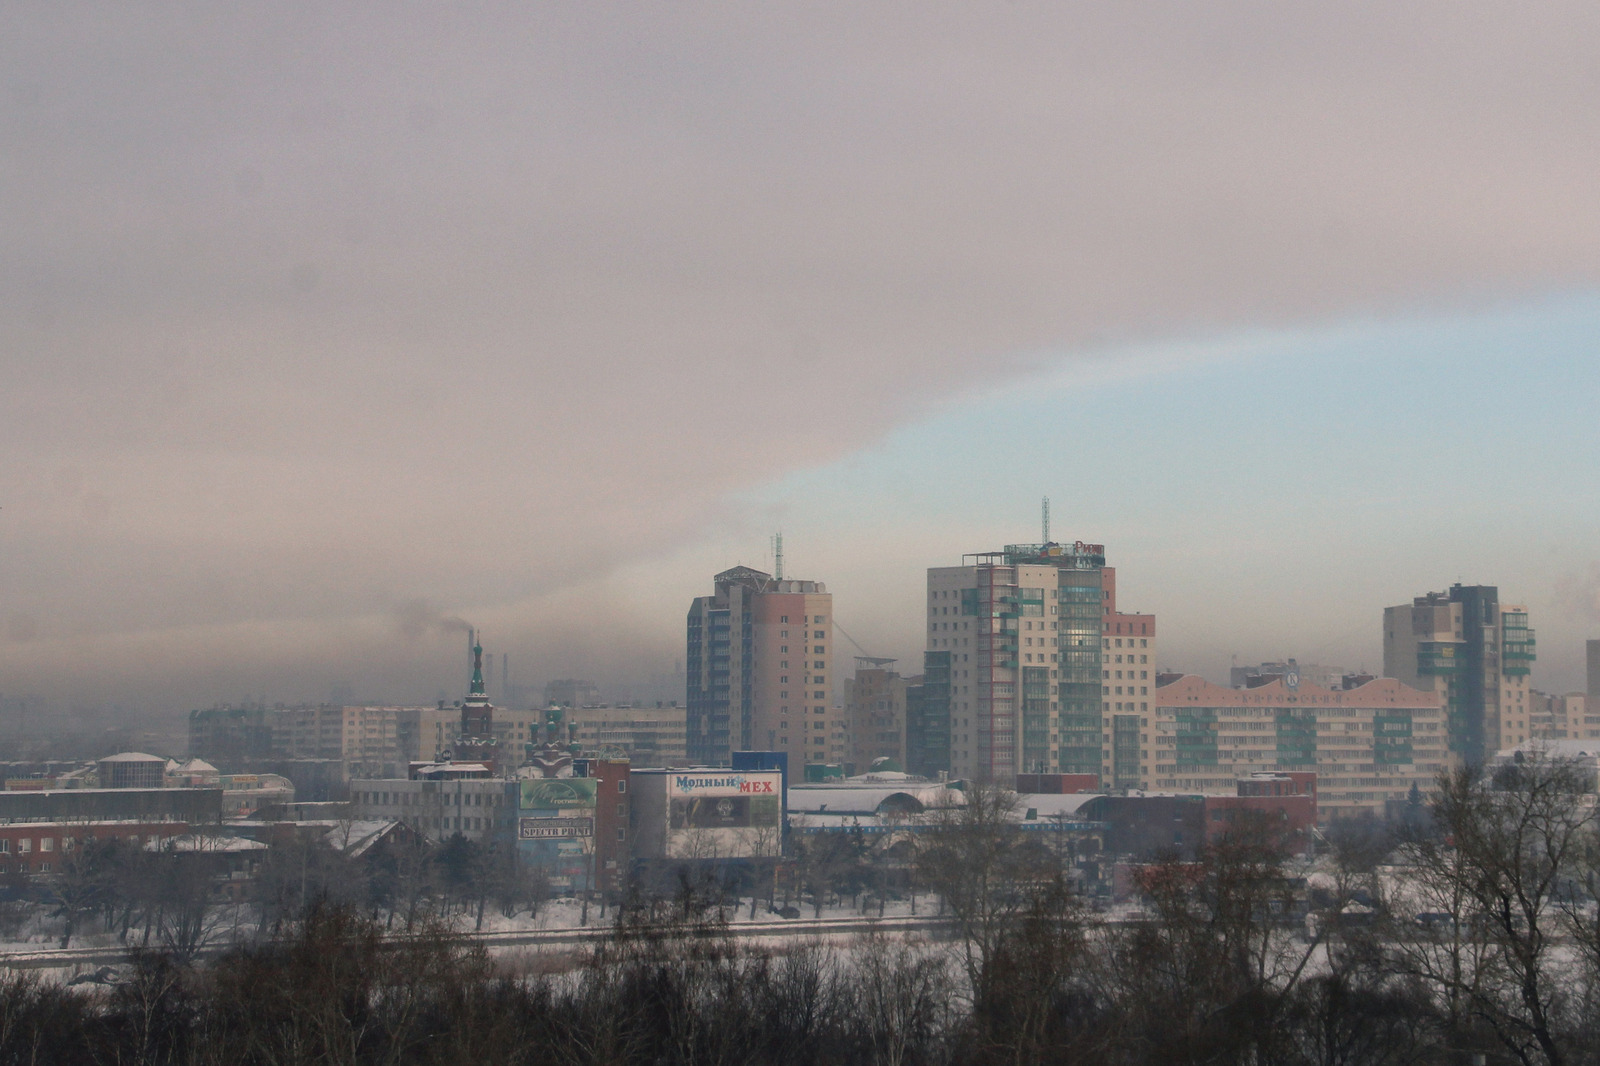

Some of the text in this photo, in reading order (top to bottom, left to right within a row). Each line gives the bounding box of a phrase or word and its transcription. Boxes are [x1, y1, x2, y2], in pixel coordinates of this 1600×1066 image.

[676, 776, 773, 792] Модный МЕХ
[524, 828, 559, 836] SPECTR
